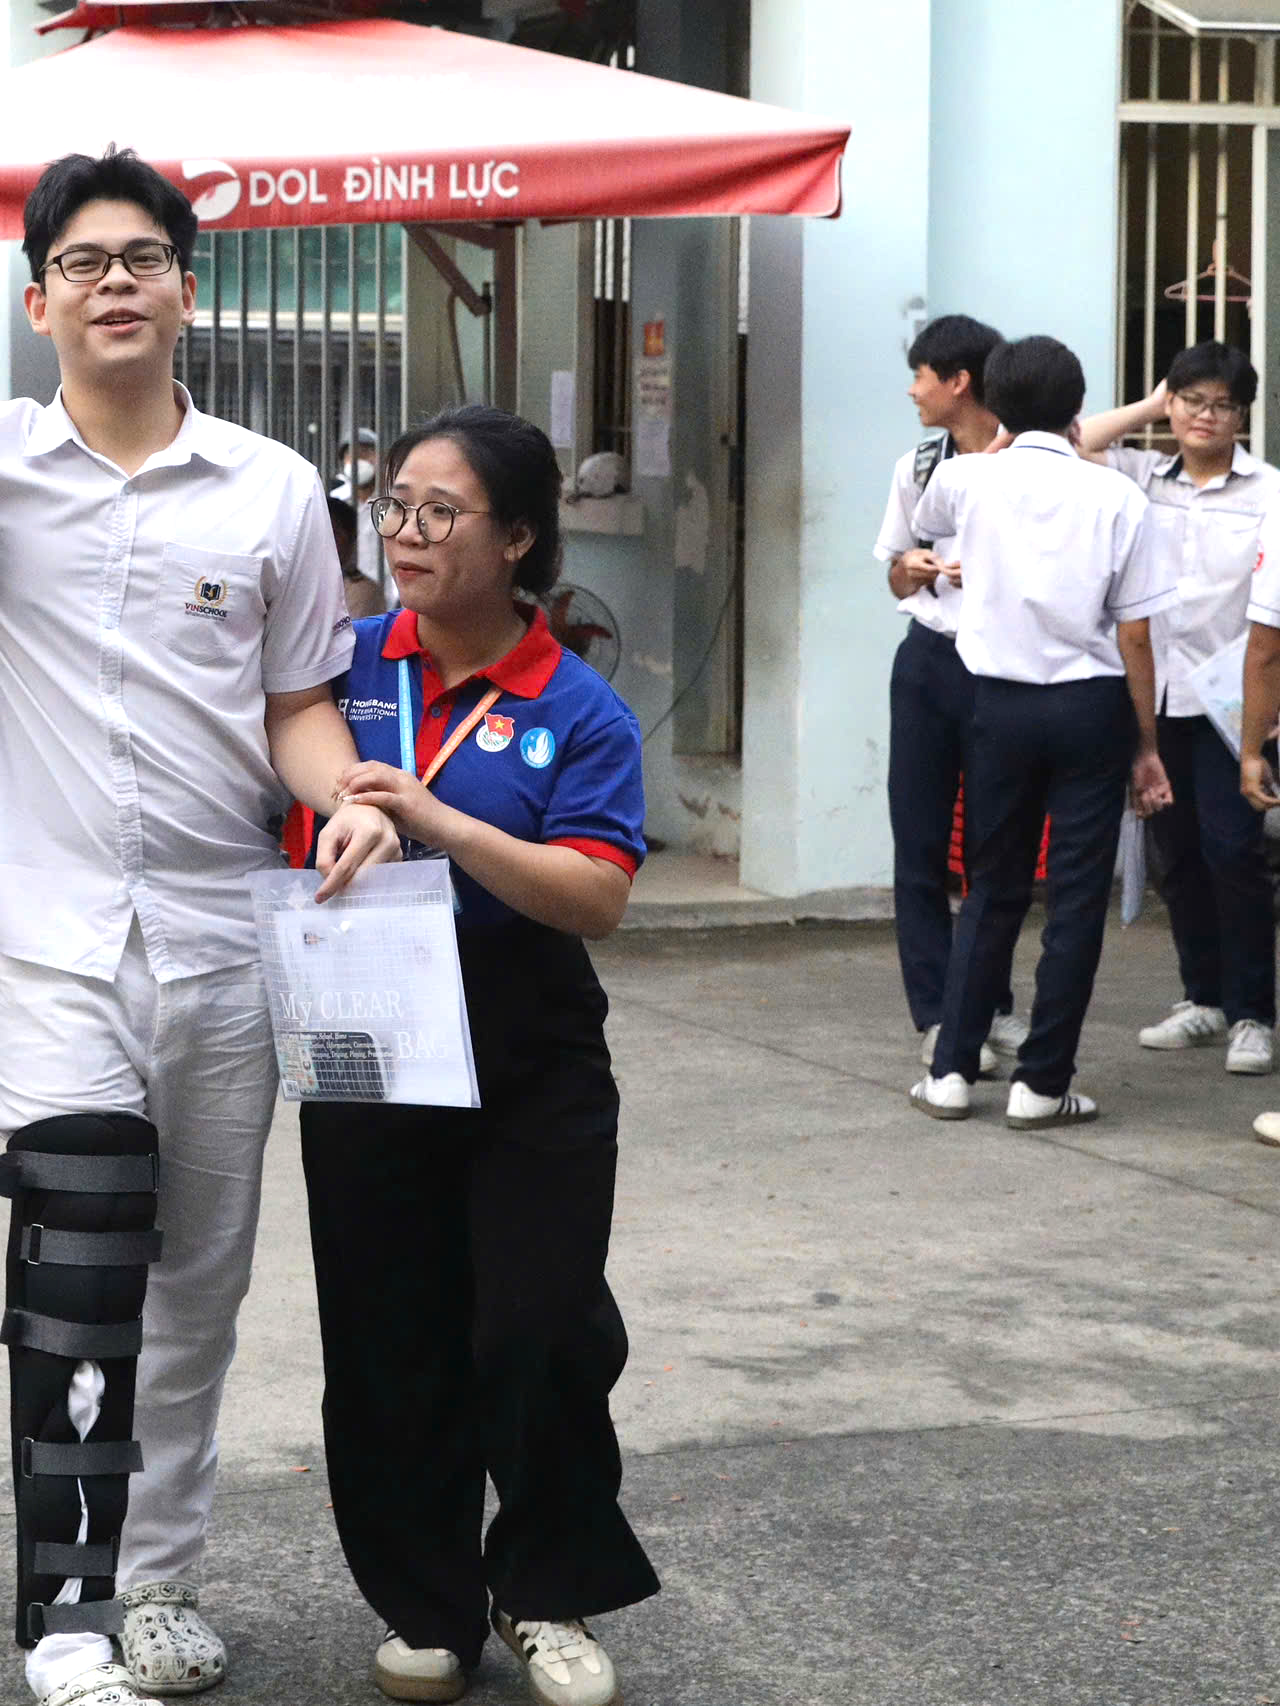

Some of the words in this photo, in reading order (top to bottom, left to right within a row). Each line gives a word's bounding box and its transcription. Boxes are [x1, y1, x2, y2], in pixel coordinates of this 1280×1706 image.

[248, 168, 329, 207] DOL
[343, 157, 435, 202] ĐÌNH
[449, 160, 520, 207] LỰC
[185, 602, 228, 618] VINSCHOOL
[279, 991, 313, 1027] My
[320, 990, 404, 1020] CLEAR
